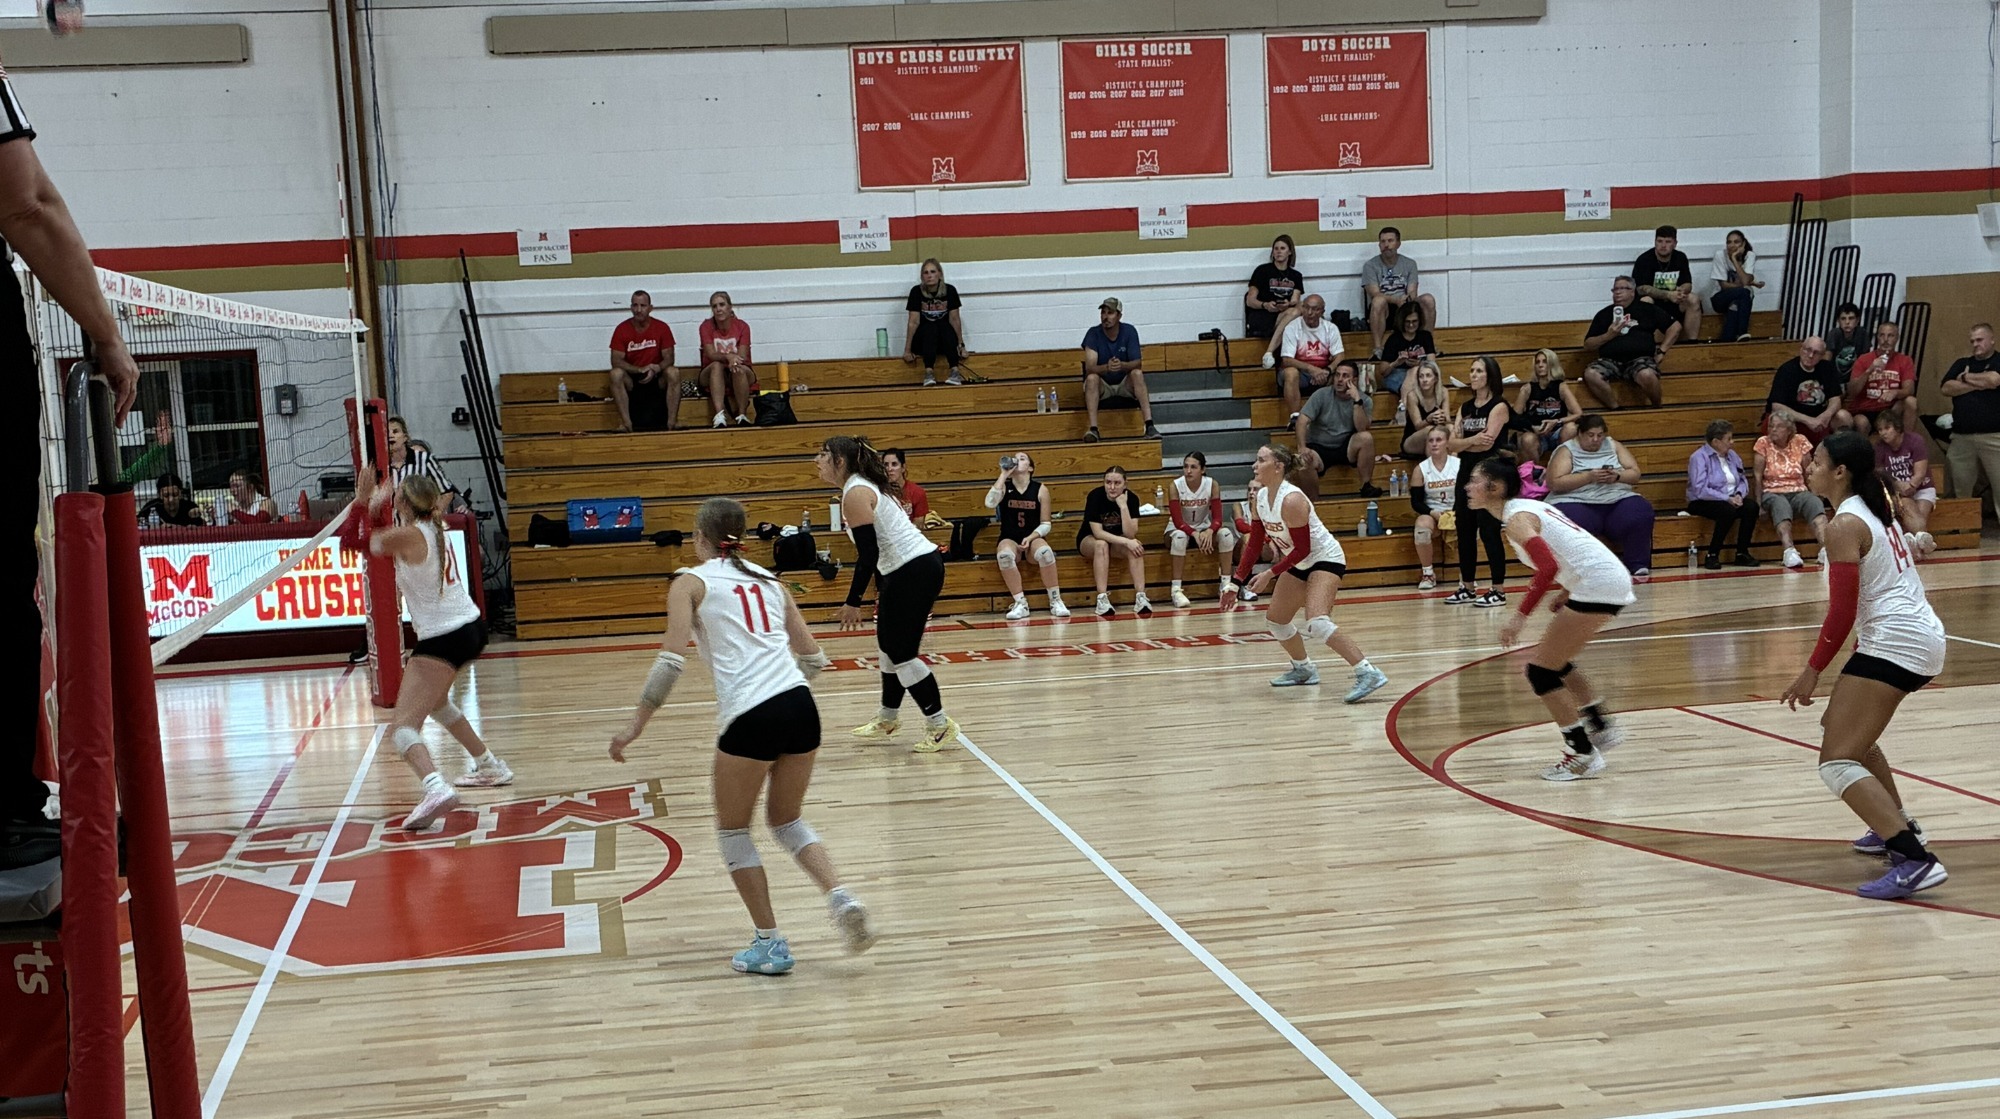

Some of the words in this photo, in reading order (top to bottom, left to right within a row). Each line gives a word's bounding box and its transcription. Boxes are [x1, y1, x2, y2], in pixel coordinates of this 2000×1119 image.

[1095, 44, 1136, 57] GIRLS
[1141, 42, 1192, 56] SOCCER
[1302, 39, 1336, 51] BOYS
[1341, 36, 1391, 50] SOCCER
[858, 52, 894, 65] BOYS
[900, 50, 943, 63] CROSS
[949, 47, 1015, 62] COUNTRY
[860, 77, 874, 85] 2011
[1110, 90, 1127, 98] 2007
[862, 123, 879, 131] 2007
[1332, 219, 1354, 228] FANS
[1152, 228, 1175, 236] FANS
[854, 241, 877, 250] FANS
[533, 253, 557, 263] FANS
[1018, 511, 1025, 528] 5
[340, 548, 362, 569] OF
[147, 554, 214, 602] M
[146, 599, 218, 624] McCOR
[732, 583, 771, 633] 11
[13, 941, 54, 995] ts
